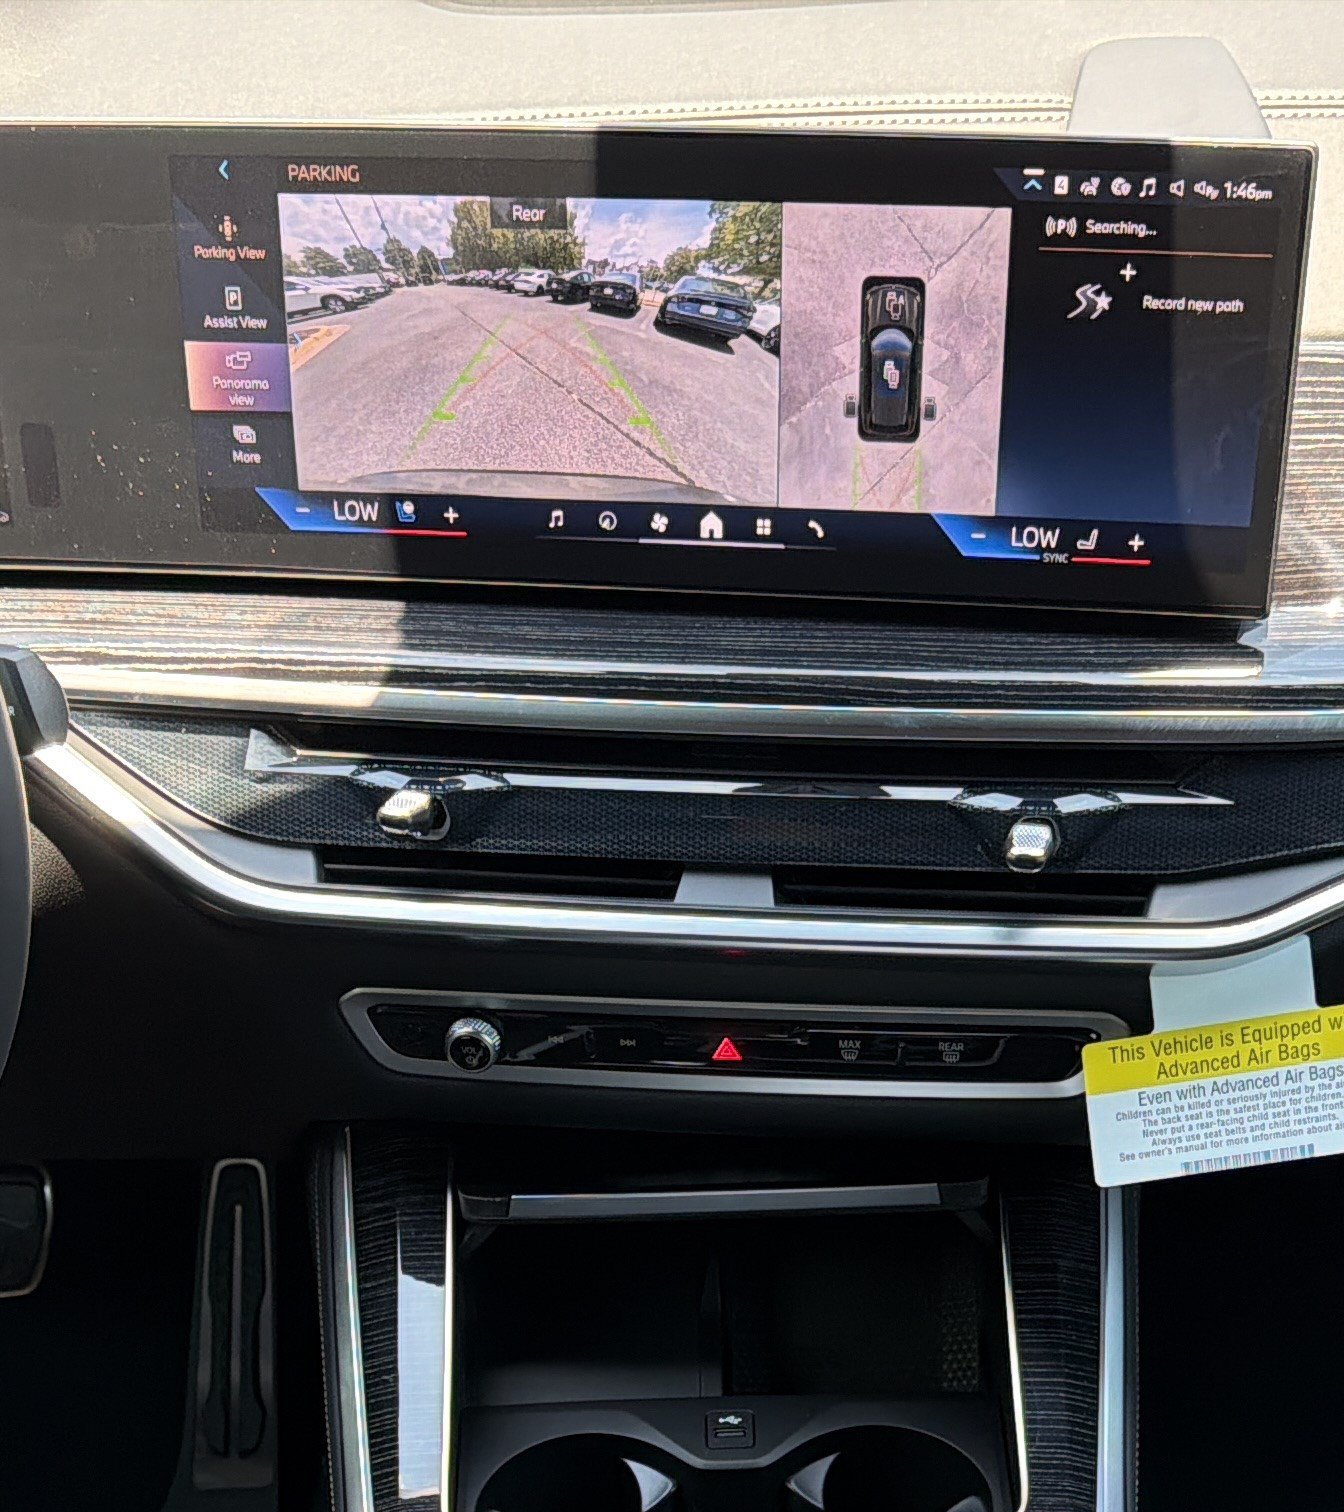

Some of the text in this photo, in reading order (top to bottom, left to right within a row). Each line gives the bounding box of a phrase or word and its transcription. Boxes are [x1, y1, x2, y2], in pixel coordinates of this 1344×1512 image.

[288, 164, 360, 183] PARKING
[513, 204, 546, 221] Rear
[1086, 219, 1157, 237] Searching...
[193, 245, 267, 262] Parking View
[1142, 295, 1244, 314] Record new path
[204, 315, 268, 330] Assist View
[213, 376, 270, 391] Panorama
[228, 394, 255, 406] view
[232, 450, 261, 464] More
[333, 499, 379, 521] LOW
[1011, 526, 1061, 549] LOW
[1042, 553, 1070, 564] SYNC
[838, 1039, 861, 1049] MAX
[938, 1042, 964, 1051] REAR
[1108, 1044, 1145, 1064] This
[1150, 1034, 1213, 1057] Vehicle
[1219, 1030, 1235, 1047] is
[1240, 1014, 1322, 1045] Equipped
[1156, 1042, 1321, 1080] Advanced Air Bags
[1138, 1064, 1344, 1107] Even with Advanced Air Bags
[1116, 1108, 1153, 1121] Children
[1156, 1107, 1171, 1116] can
[1174, 1104, 1185, 1113] be
[1187, 1100, 1211, 1111] killed
[1214, 1099, 1224, 1107] or
[1304, 1084, 1315, 1096] by
[1318, 1082, 1332, 1091] the
[1142, 1118, 1158, 1128] The
[1161, 1114, 1181, 1125] back
[1184, 1110, 1203, 1120] seat
[1205, 1109, 1214, 1118] is
[1216, 1107, 1231, 1117] the
[1233, 1102, 1259, 1114] safest
[1263, 1099, 1286, 1111] place
[1289, 1096, 1302, 1106] for
[1142, 1127, 1167, 1138] Never
[1170, 1124, 1185, 1136] put
[1247, 1111, 1269, 1123] child
[1272, 1108, 1291, 1119] seat
[1293, 1107, 1302, 1116] in
[1304, 1105, 1319, 1114] the
[1151, 1134, 1183, 1147] Always
[1185, 1133, 1201, 1142] use
[1203, 1129, 1223, 1140] seat
[1225, 1125, 1247, 1137] belts
[1249, 1122, 1266, 1133] and
[1268, 1118, 1290, 1130] child
[1119, 1151, 1136, 1162] See
[1175, 1142, 1207, 1154] manual
[1210, 1139, 1223, 1149] for
[1226, 1136, 1249, 1146] more
[1307, 1123, 1332, 1135] about
